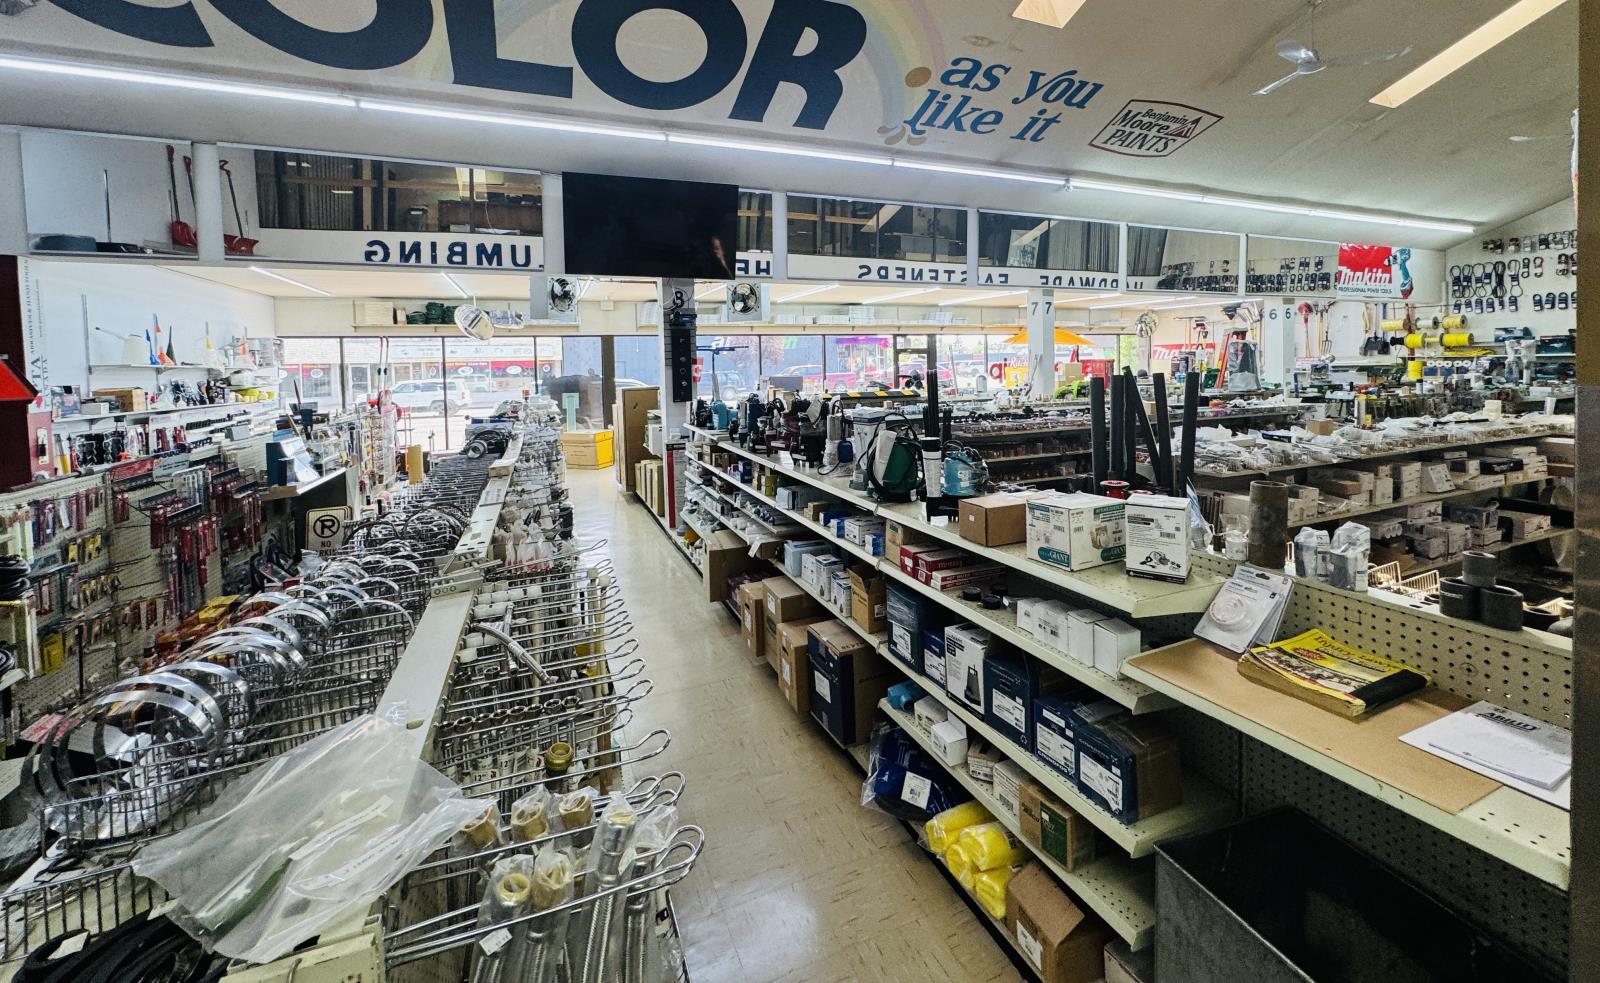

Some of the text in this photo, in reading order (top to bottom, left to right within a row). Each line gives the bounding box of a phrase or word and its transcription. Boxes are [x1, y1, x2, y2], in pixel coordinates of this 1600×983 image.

[940, 56, 1104, 109] as you
[903, 88, 1063, 143] like it
[1112, 109, 1170, 135] Moore
[1141, 108, 1188, 125] Benjamin
[1102, 128, 1179, 154] PAINTS
[1031, 301, 1039, 316] 7
[1044, 301, 1053, 315] 7
[1269, 308, 1278, 320] 6
[1285, 307, 1292, 320] 6
[320, 540, 332, 548] NO
